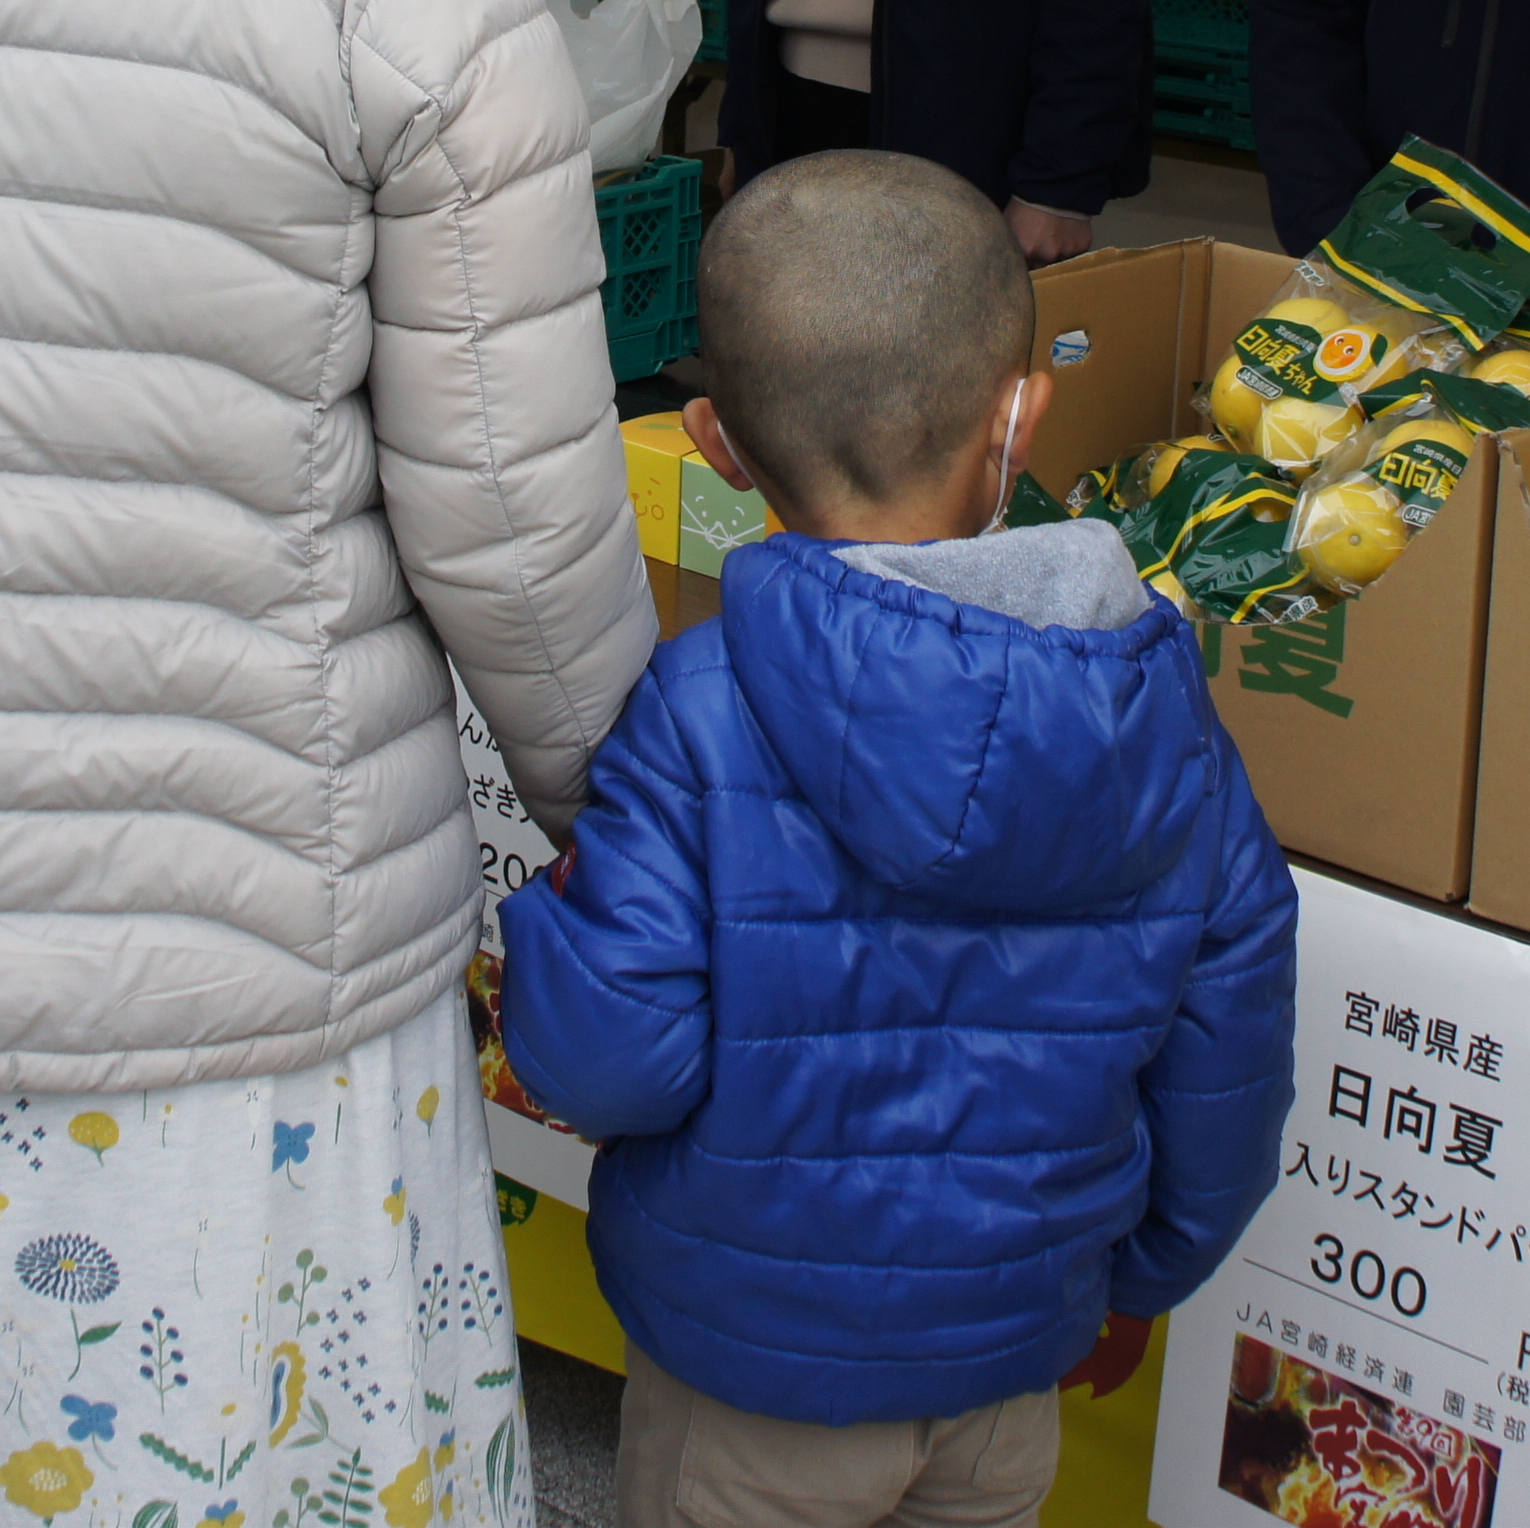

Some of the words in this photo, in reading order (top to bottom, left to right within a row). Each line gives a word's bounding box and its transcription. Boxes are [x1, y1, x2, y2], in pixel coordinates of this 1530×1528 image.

[1236, 324, 1320, 396] 日向夏ちゃん
[1343, 990, 1505, 1083] 宮崎県産
[1327, 1063, 1504, 1180] 日向夏
[1309, 1232, 1429, 1320] 300
[1235, 1302, 1416, 1397] JA宮崎経済連
[1442, 1388, 1529, 1445] 園芸部
